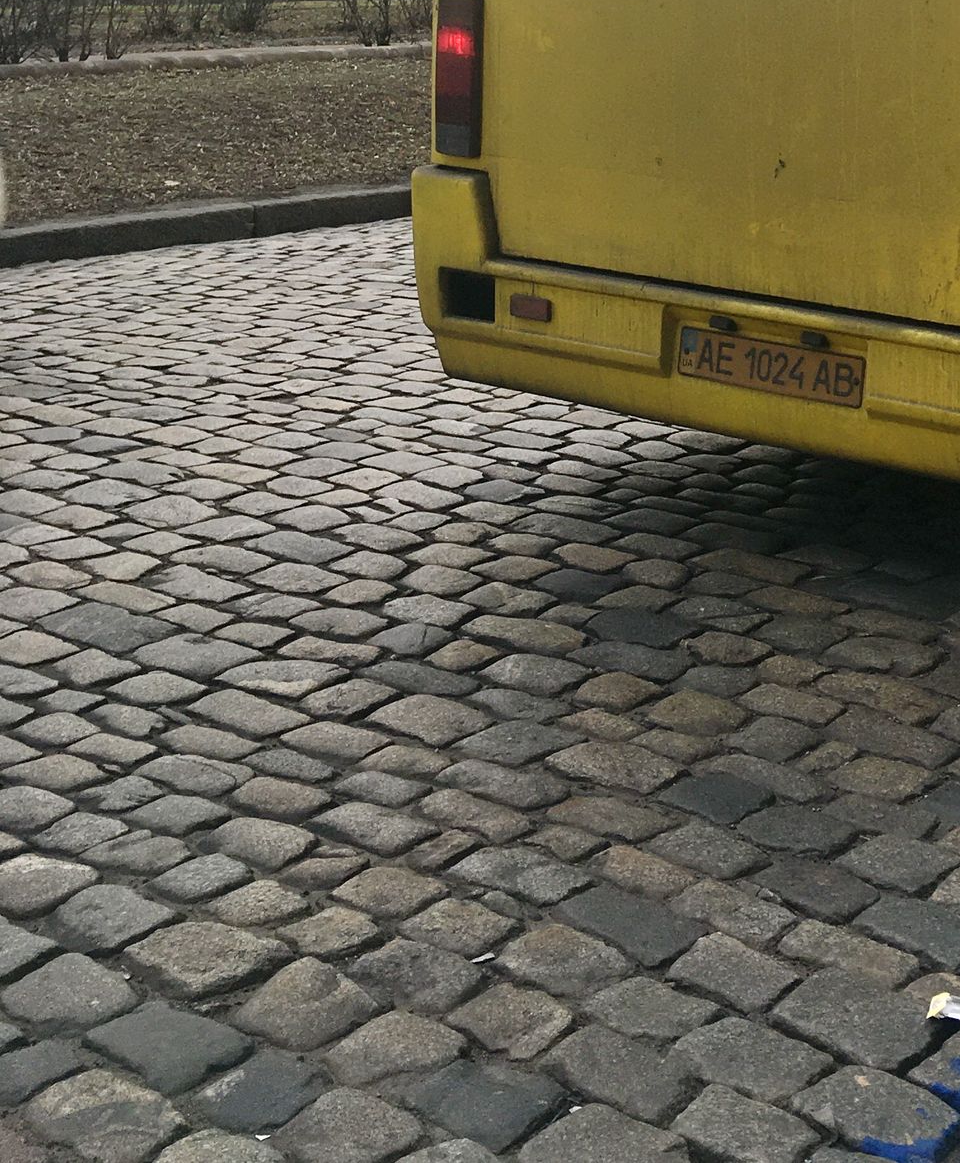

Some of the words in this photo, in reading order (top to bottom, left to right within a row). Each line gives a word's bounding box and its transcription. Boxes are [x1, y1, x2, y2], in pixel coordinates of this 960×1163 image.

[682, 357, 693, 368] UA
[697, 338, 736, 376] AE
[744, 347, 804, 390] 1024
[812, 359, 855, 398] AB
